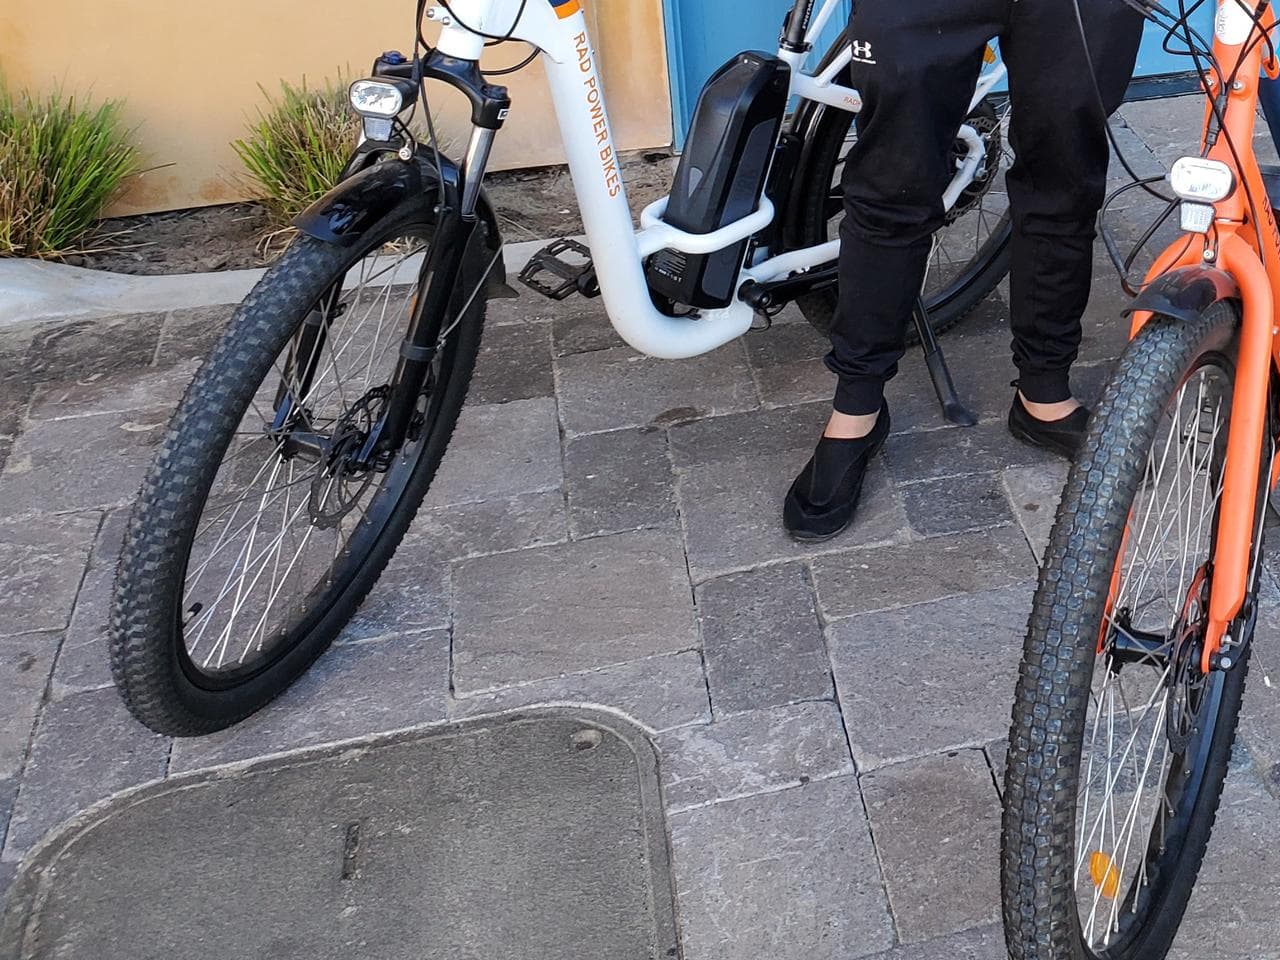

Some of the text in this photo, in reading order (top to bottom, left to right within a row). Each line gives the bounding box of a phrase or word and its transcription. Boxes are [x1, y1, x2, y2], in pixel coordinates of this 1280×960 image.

[573, 30, 621, 198] RAD POWER BIKES
